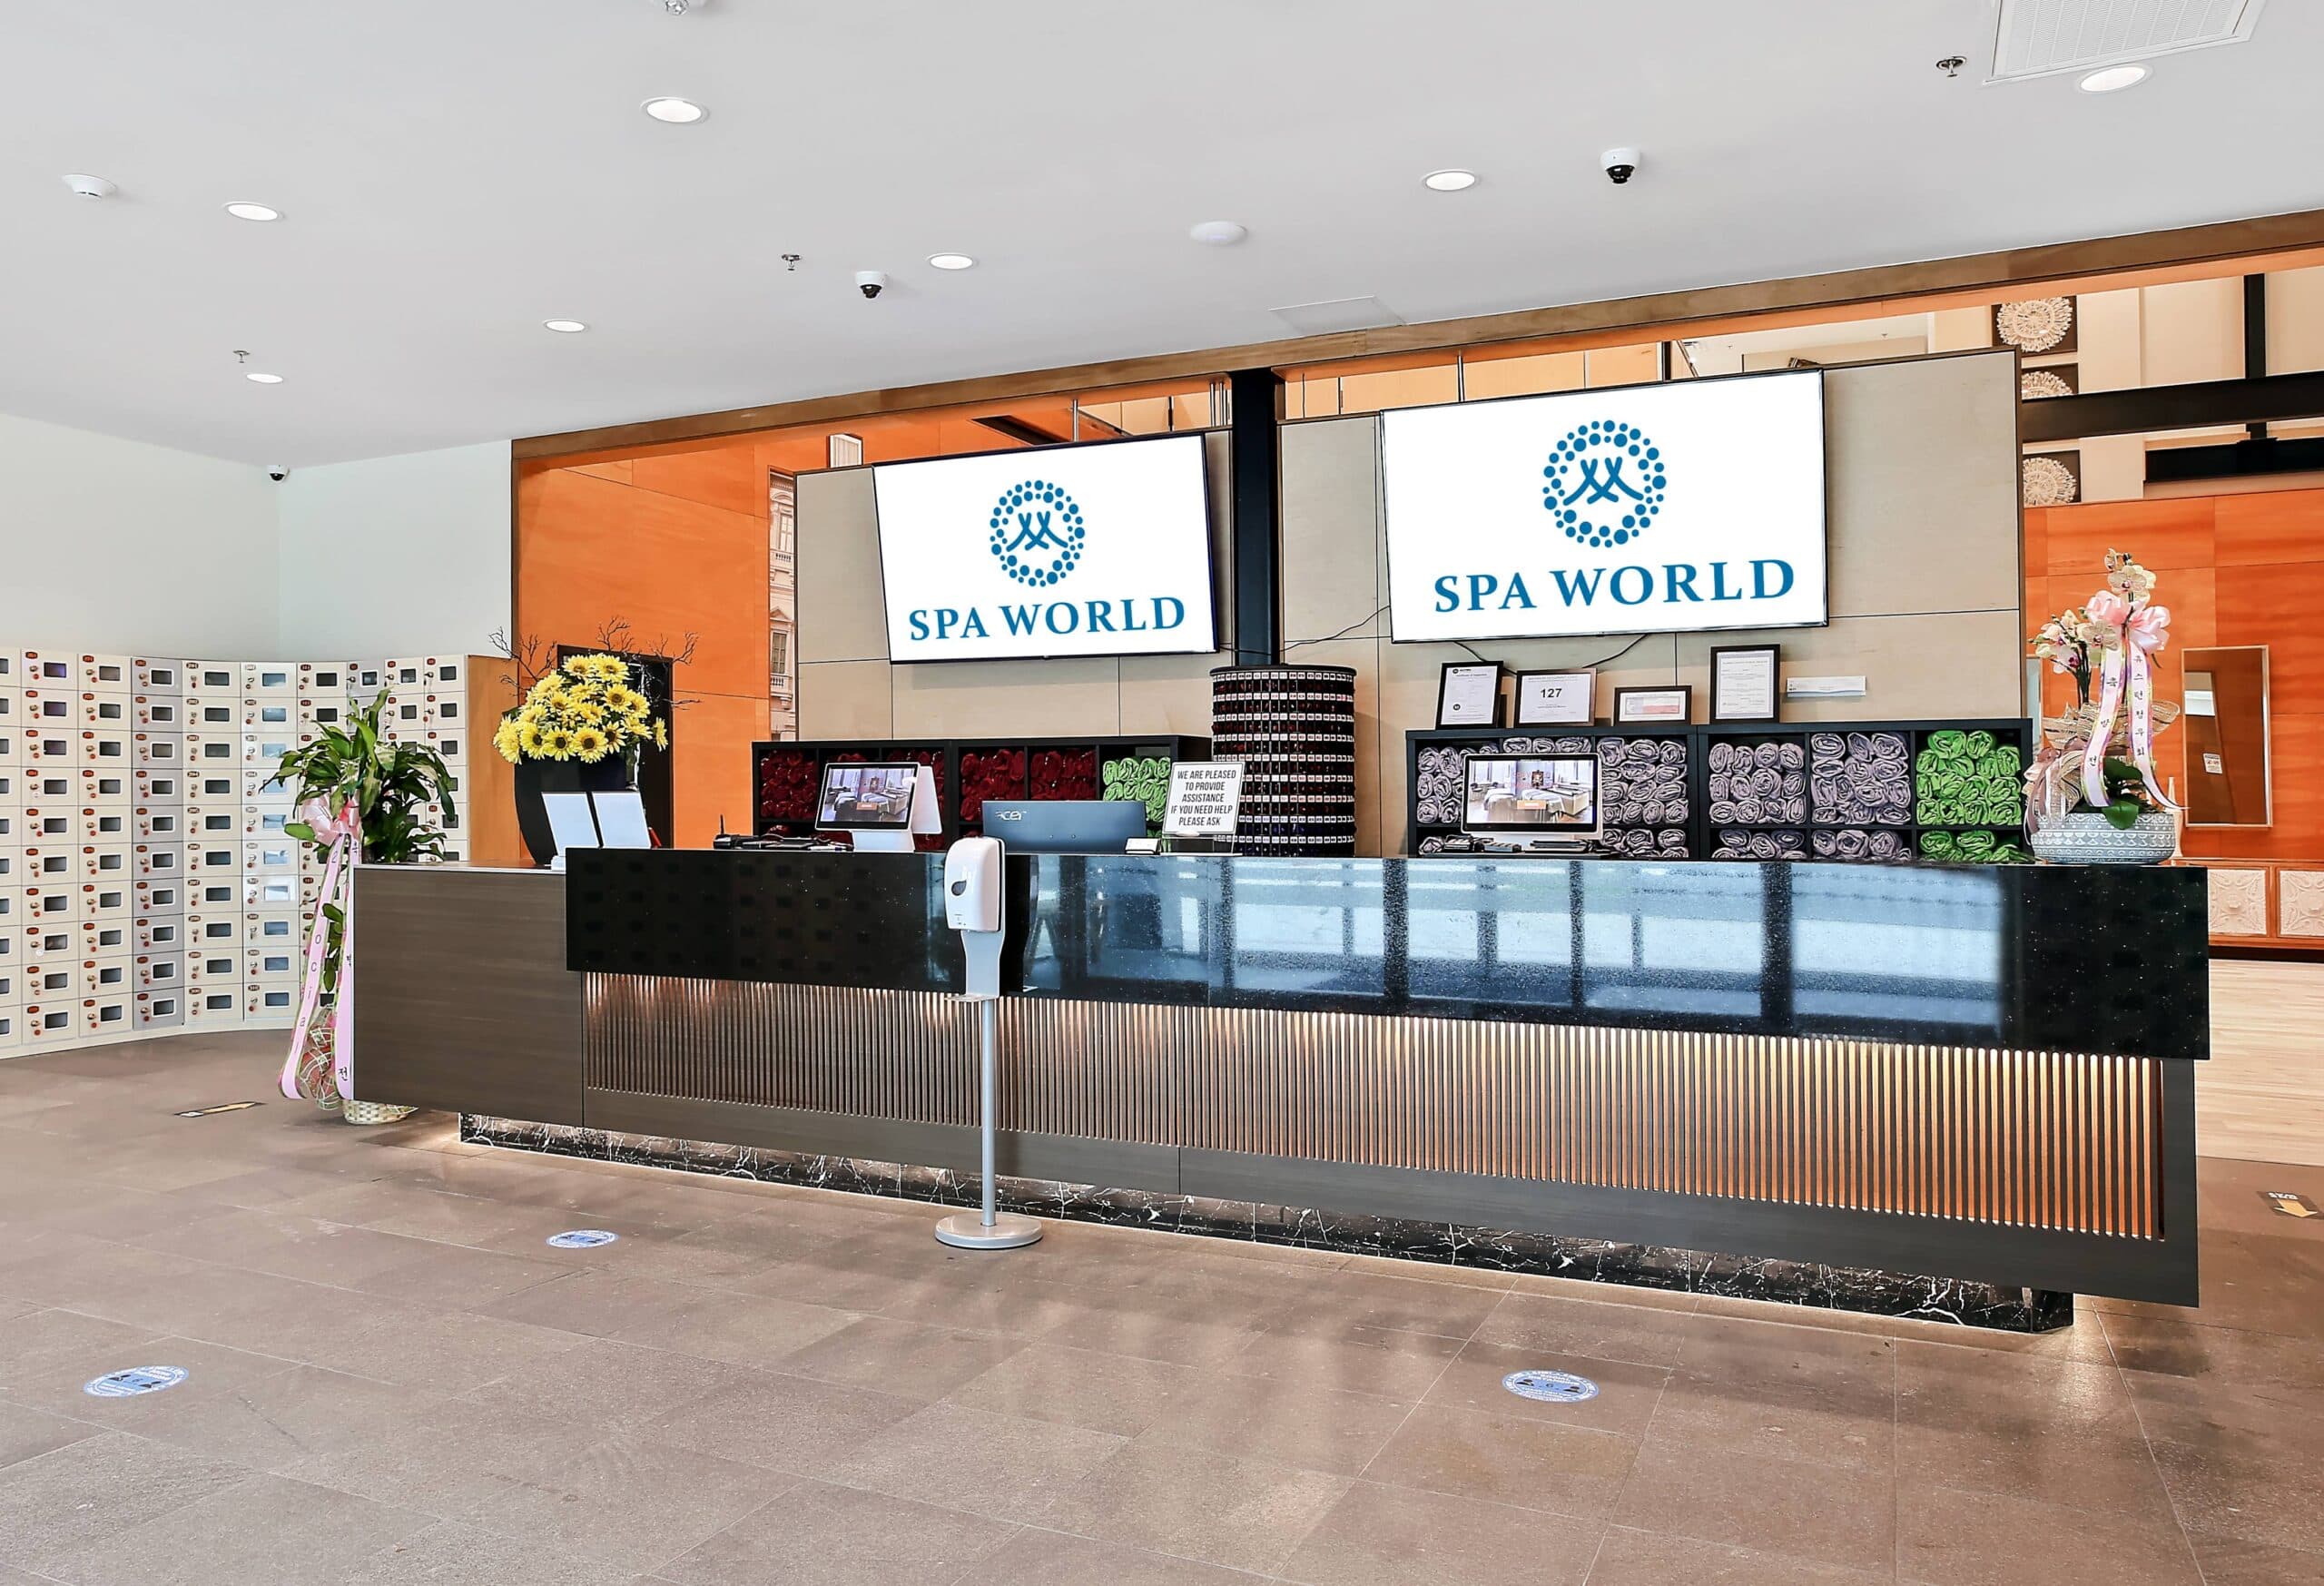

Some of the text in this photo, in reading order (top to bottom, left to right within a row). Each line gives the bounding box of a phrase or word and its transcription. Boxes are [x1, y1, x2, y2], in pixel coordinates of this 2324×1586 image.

[1434, 558, 1795, 613] SPA WORLD
[908, 596, 1186, 641] SPA WORLD
[1540, 687, 1562, 698] 127
[1177, 769, 1236, 779] WE ARE PLEASED
[1185, 781, 1226, 791] TO PROVIDE
[1182, 793, 1225, 803] ASSISTANCE
[1171, 804, 1233, 814] IF YOU NEED HELP
[995, 810, 1028, 821] acer
[1178, 816, 1221, 826] PLEASE ASK
